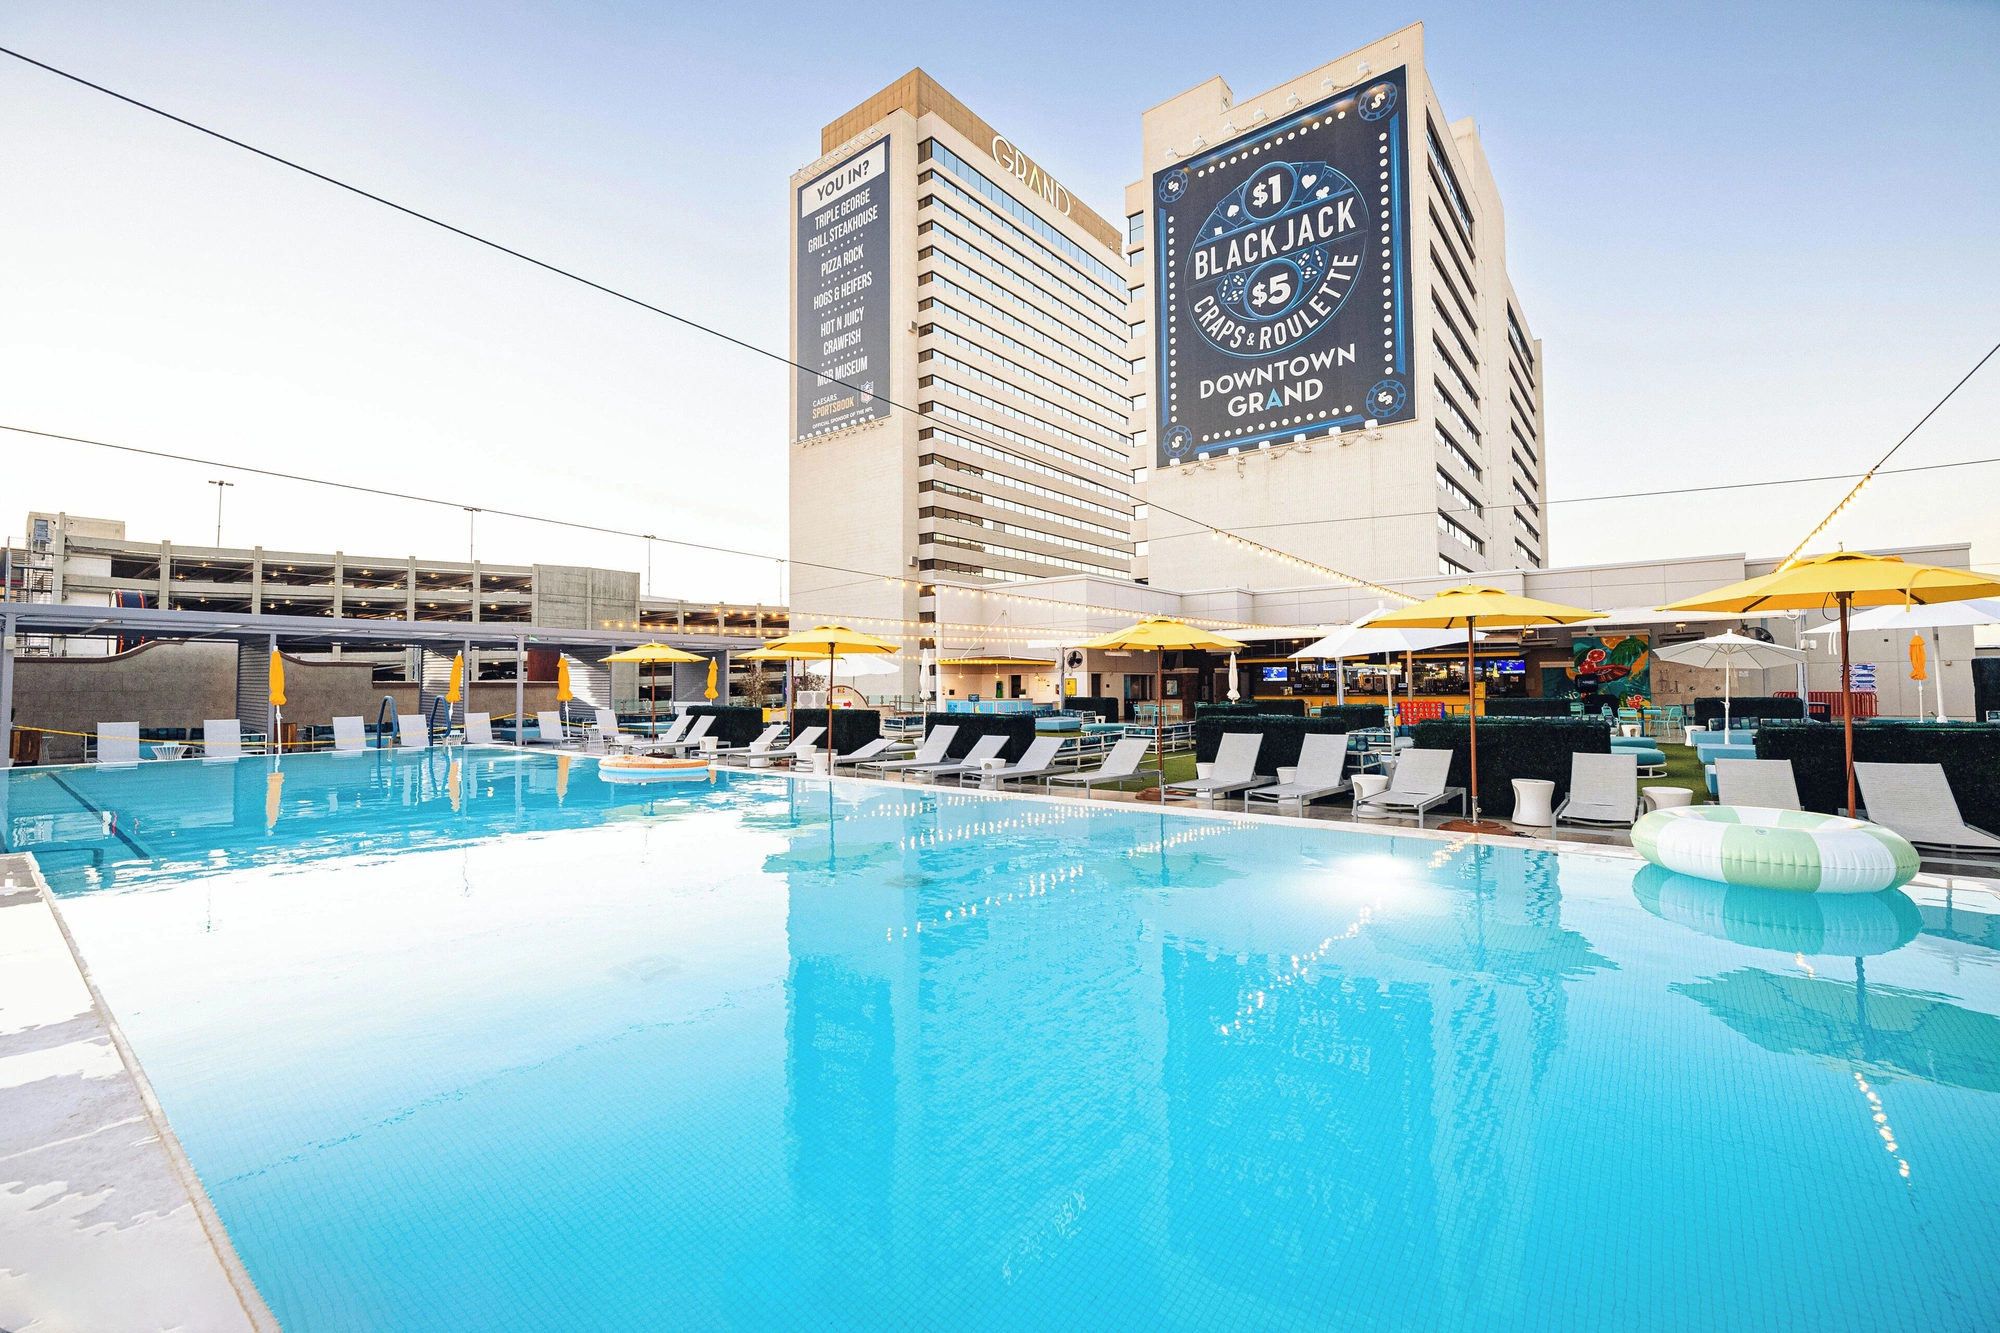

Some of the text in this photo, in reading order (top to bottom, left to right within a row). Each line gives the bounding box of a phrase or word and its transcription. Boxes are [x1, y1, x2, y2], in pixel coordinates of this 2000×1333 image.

[817, 159, 870, 201] YOU IN?
[992, 135, 1071, 217] GRAND
[1252, 174, 1282, 208] $1
[815, 188, 871, 230] TRIPLE GEORGE
[808, 204, 878, 254] GRILL STEAKHOUSE
[821, 243, 864, 277] PIZZA ROCK
[813, 271, 872, 311] HOGS & HEIFERS
[1194, 254, 1359, 350] CRAPS & ROULETTE
[1252, 272, 1291, 307] $5
[820, 306, 865, 338] HOT N JUICY
[823, 328, 861, 356] CRAWFISH
[817, 355, 868, 387] MOB MUSEUM
[1200, 343, 1356, 399] DOWNTOWN
[812, 393, 838, 407] CAESARS
[812, 395, 855, 419] SPORTSBOOK
[1227, 378, 1324, 417] GRAND
[812, 420, 830, 430] OFFICIAL
[830, 413, 850, 424] SPONSOR
